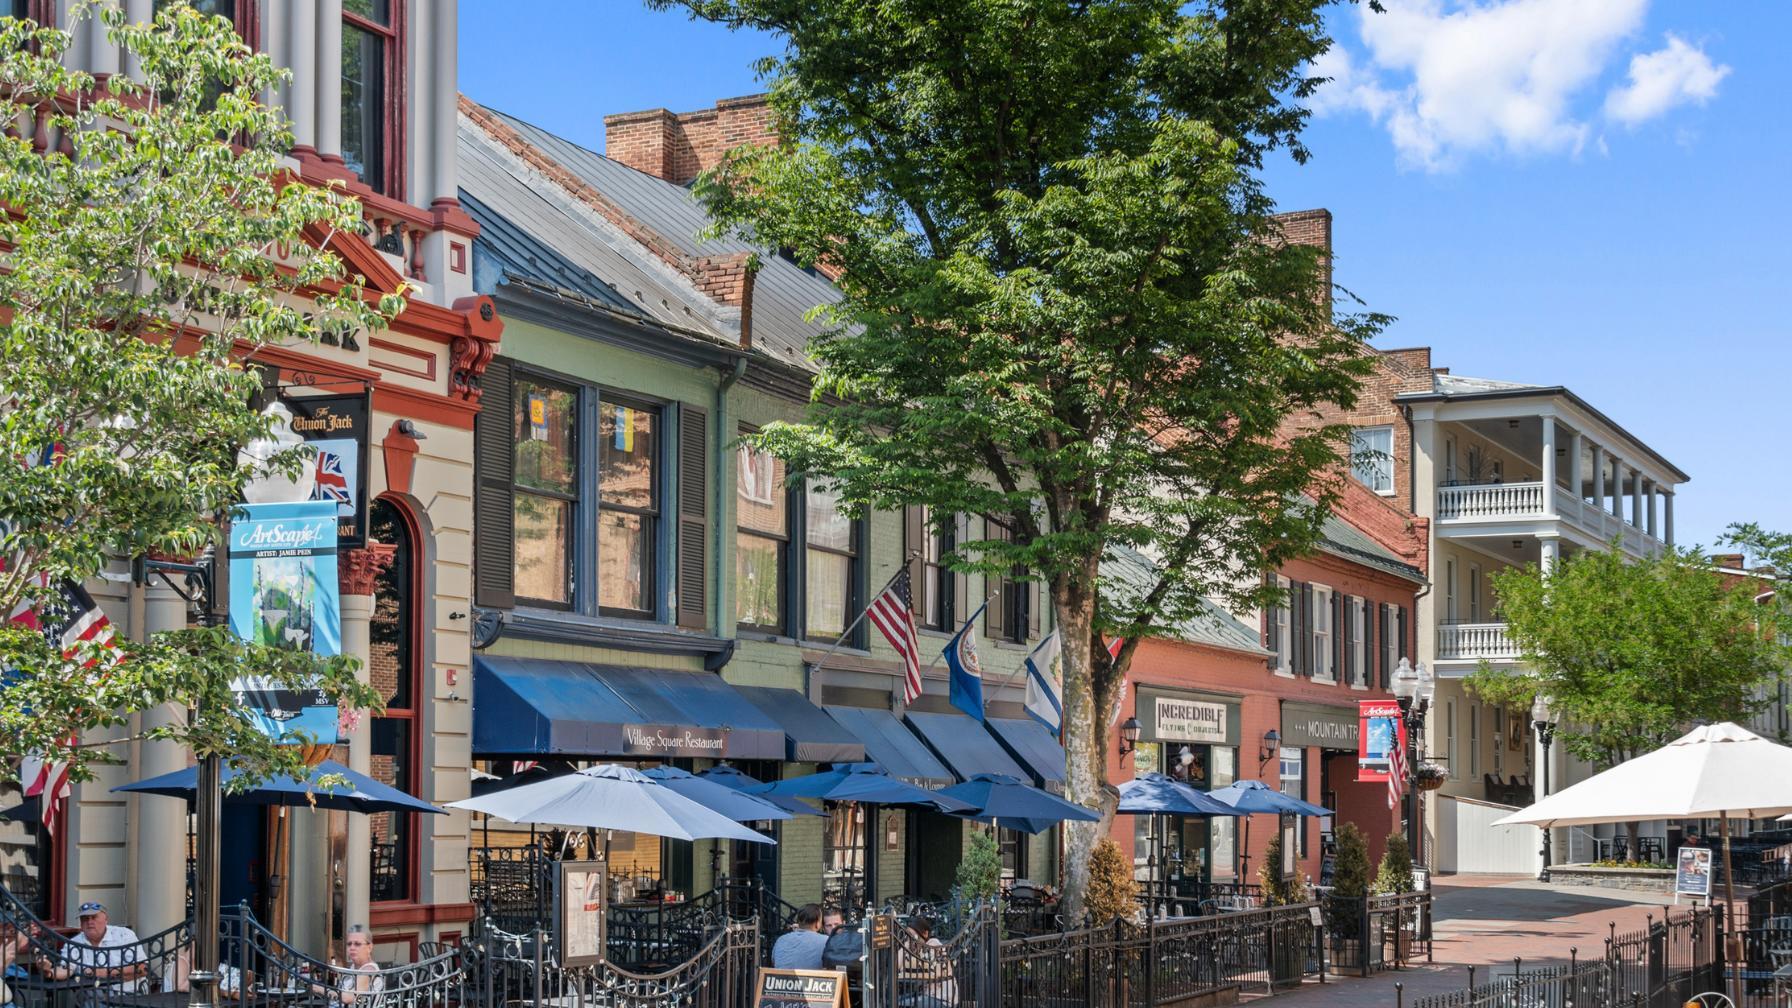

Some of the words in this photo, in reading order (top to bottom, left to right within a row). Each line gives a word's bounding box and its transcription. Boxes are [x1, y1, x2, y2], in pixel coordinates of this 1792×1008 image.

[293, 415, 327, 432] Union
[327, 414, 353, 432] Jack
[1157, 703, 1225, 734] INCREDIBLE
[1308, 721, 1347, 739] MOUNTAIN
[627, 727, 656, 751] Village
[656, 729, 684, 752] Square
[685, 730, 724, 750] Restaurant
[765, 976, 803, 991] UNION
[804, 978, 833, 993] JACK
